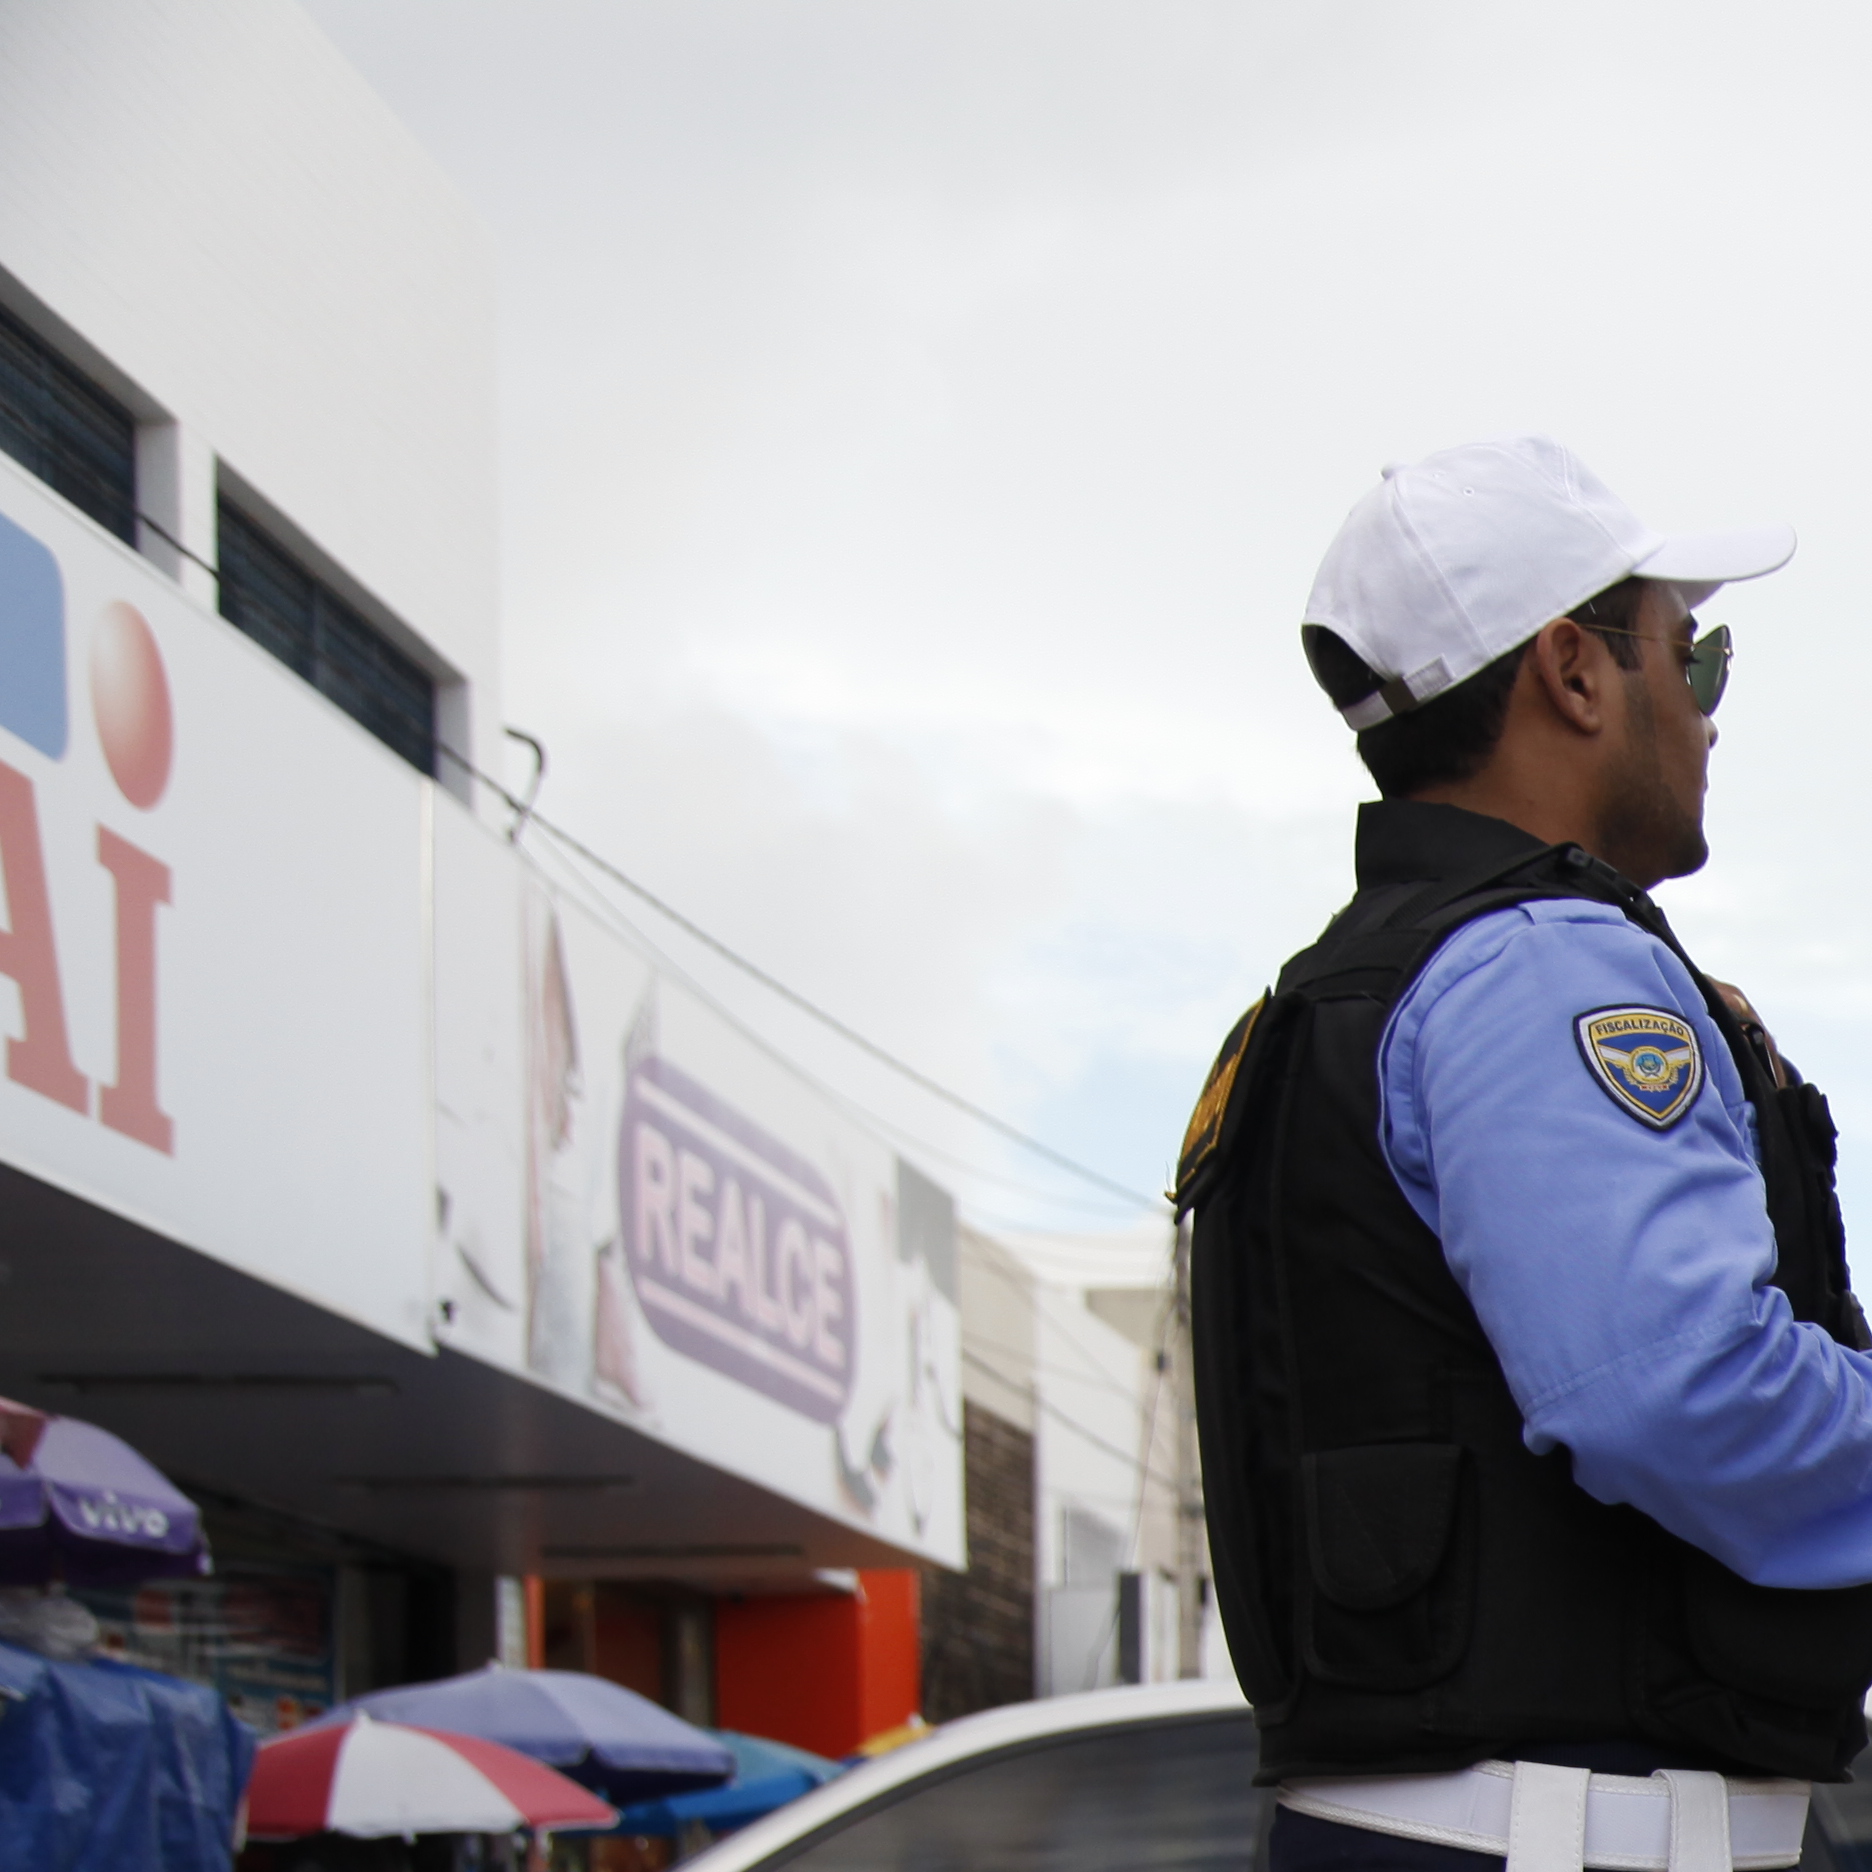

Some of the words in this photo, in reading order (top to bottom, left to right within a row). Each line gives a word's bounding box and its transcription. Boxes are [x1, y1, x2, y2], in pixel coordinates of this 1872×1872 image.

[1595, 1019, 1684, 1036] FISCALIZAÇÃO
[633, 1120, 847, 1371] REALCE
[79, 1490, 169, 1538] vivo
